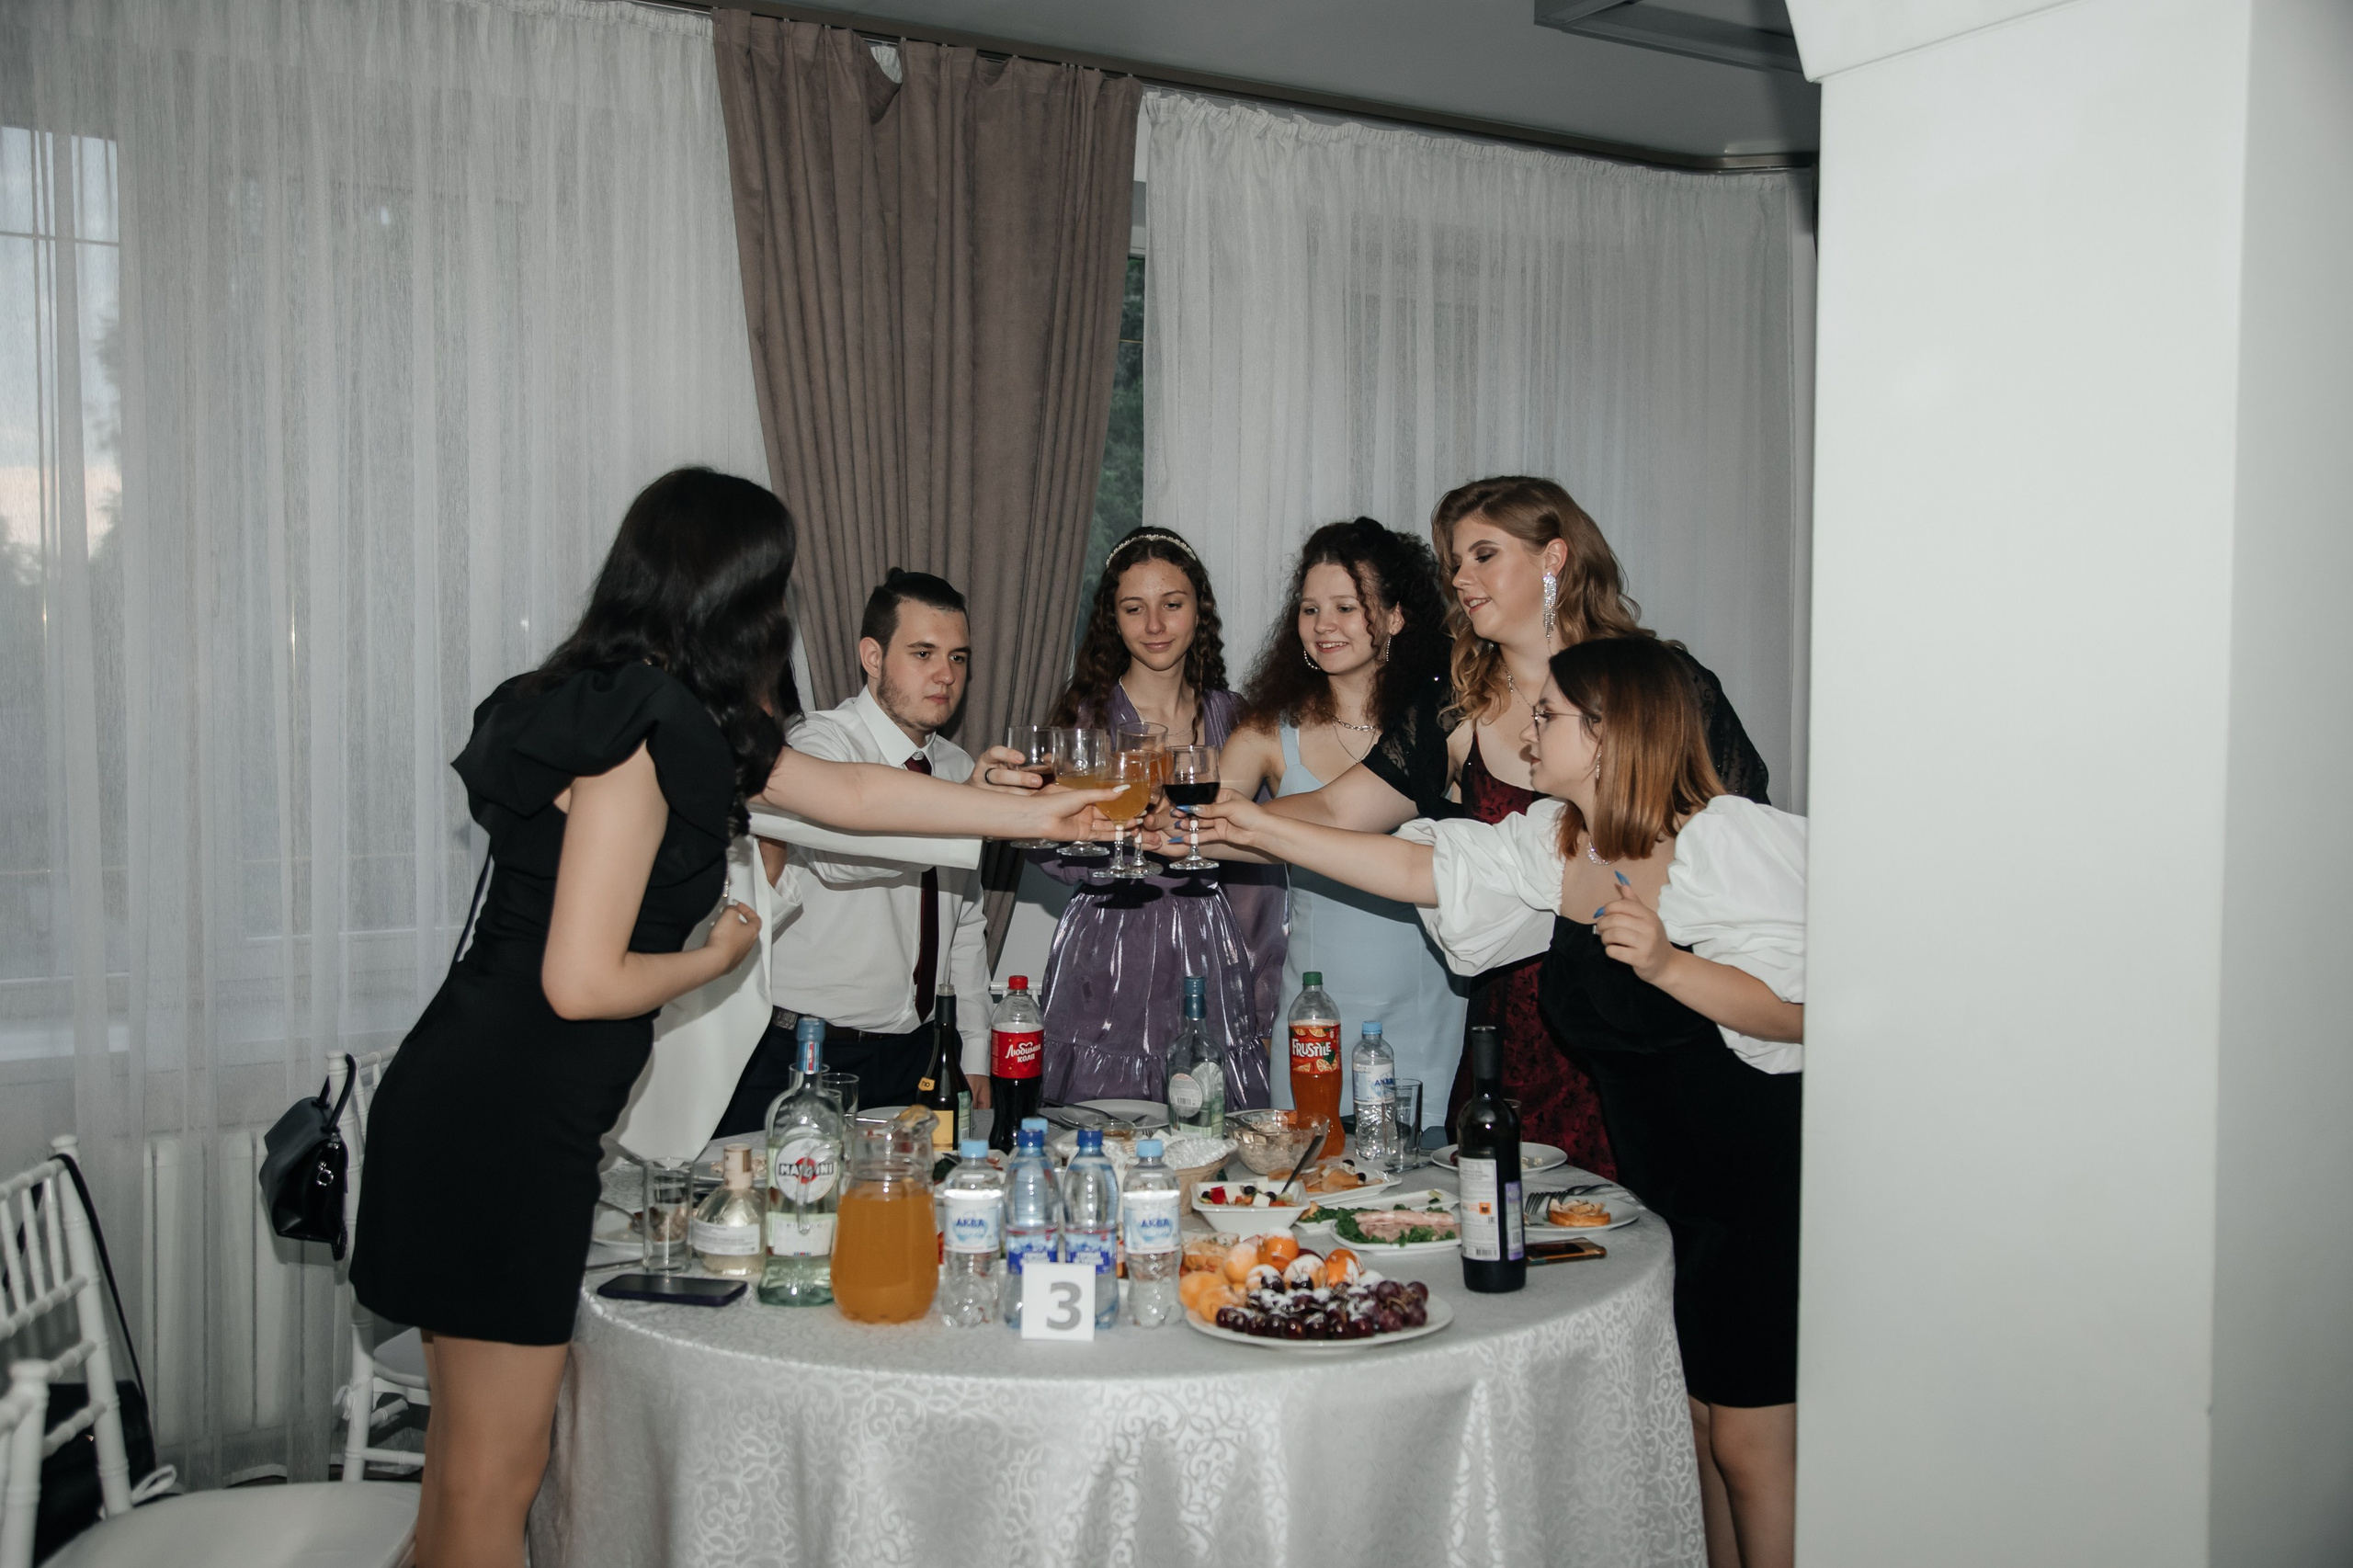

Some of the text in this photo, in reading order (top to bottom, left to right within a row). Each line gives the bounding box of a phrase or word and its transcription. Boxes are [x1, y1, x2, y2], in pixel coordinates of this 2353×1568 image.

[1005, 1041, 1041, 1059] Любимая
[1017, 1053, 1035, 1062] кола
[779, 1162, 835, 1176] MAINI
[1046, 1281, 1083, 1332] 3
